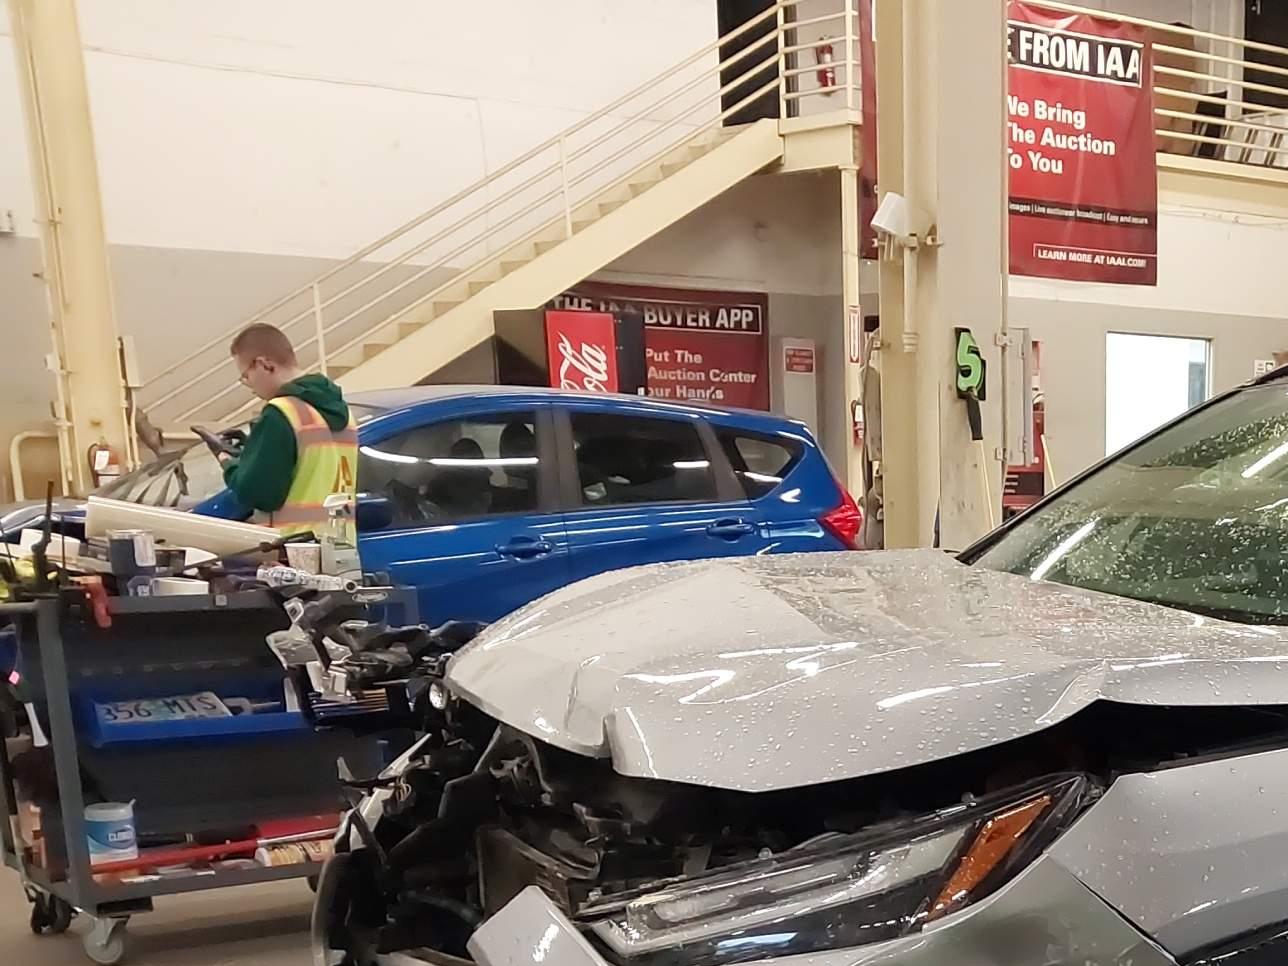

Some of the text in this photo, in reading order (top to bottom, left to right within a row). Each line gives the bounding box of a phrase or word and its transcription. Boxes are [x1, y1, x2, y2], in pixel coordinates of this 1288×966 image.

[1019, 29, 1090, 73] FROM
[1097, 43, 1140, 79] IAA
[1034, 99, 1086, 130] Bring
[1040, 126, 1116, 156] Auction
[1027, 150, 1063, 174] You
[1037, 248, 1067, 260] LEARN
[1068, 252, 1092, 263] MORE
[1093, 256, 1105, 264] AT
[643, 306, 710, 328] BUYER
[715, 308, 754, 329] APP
[645, 348, 703, 363] Put The
[957, 330, 983, 393] 5
[648, 366, 706, 381] Auction
[104, 702, 152, 721] 356
